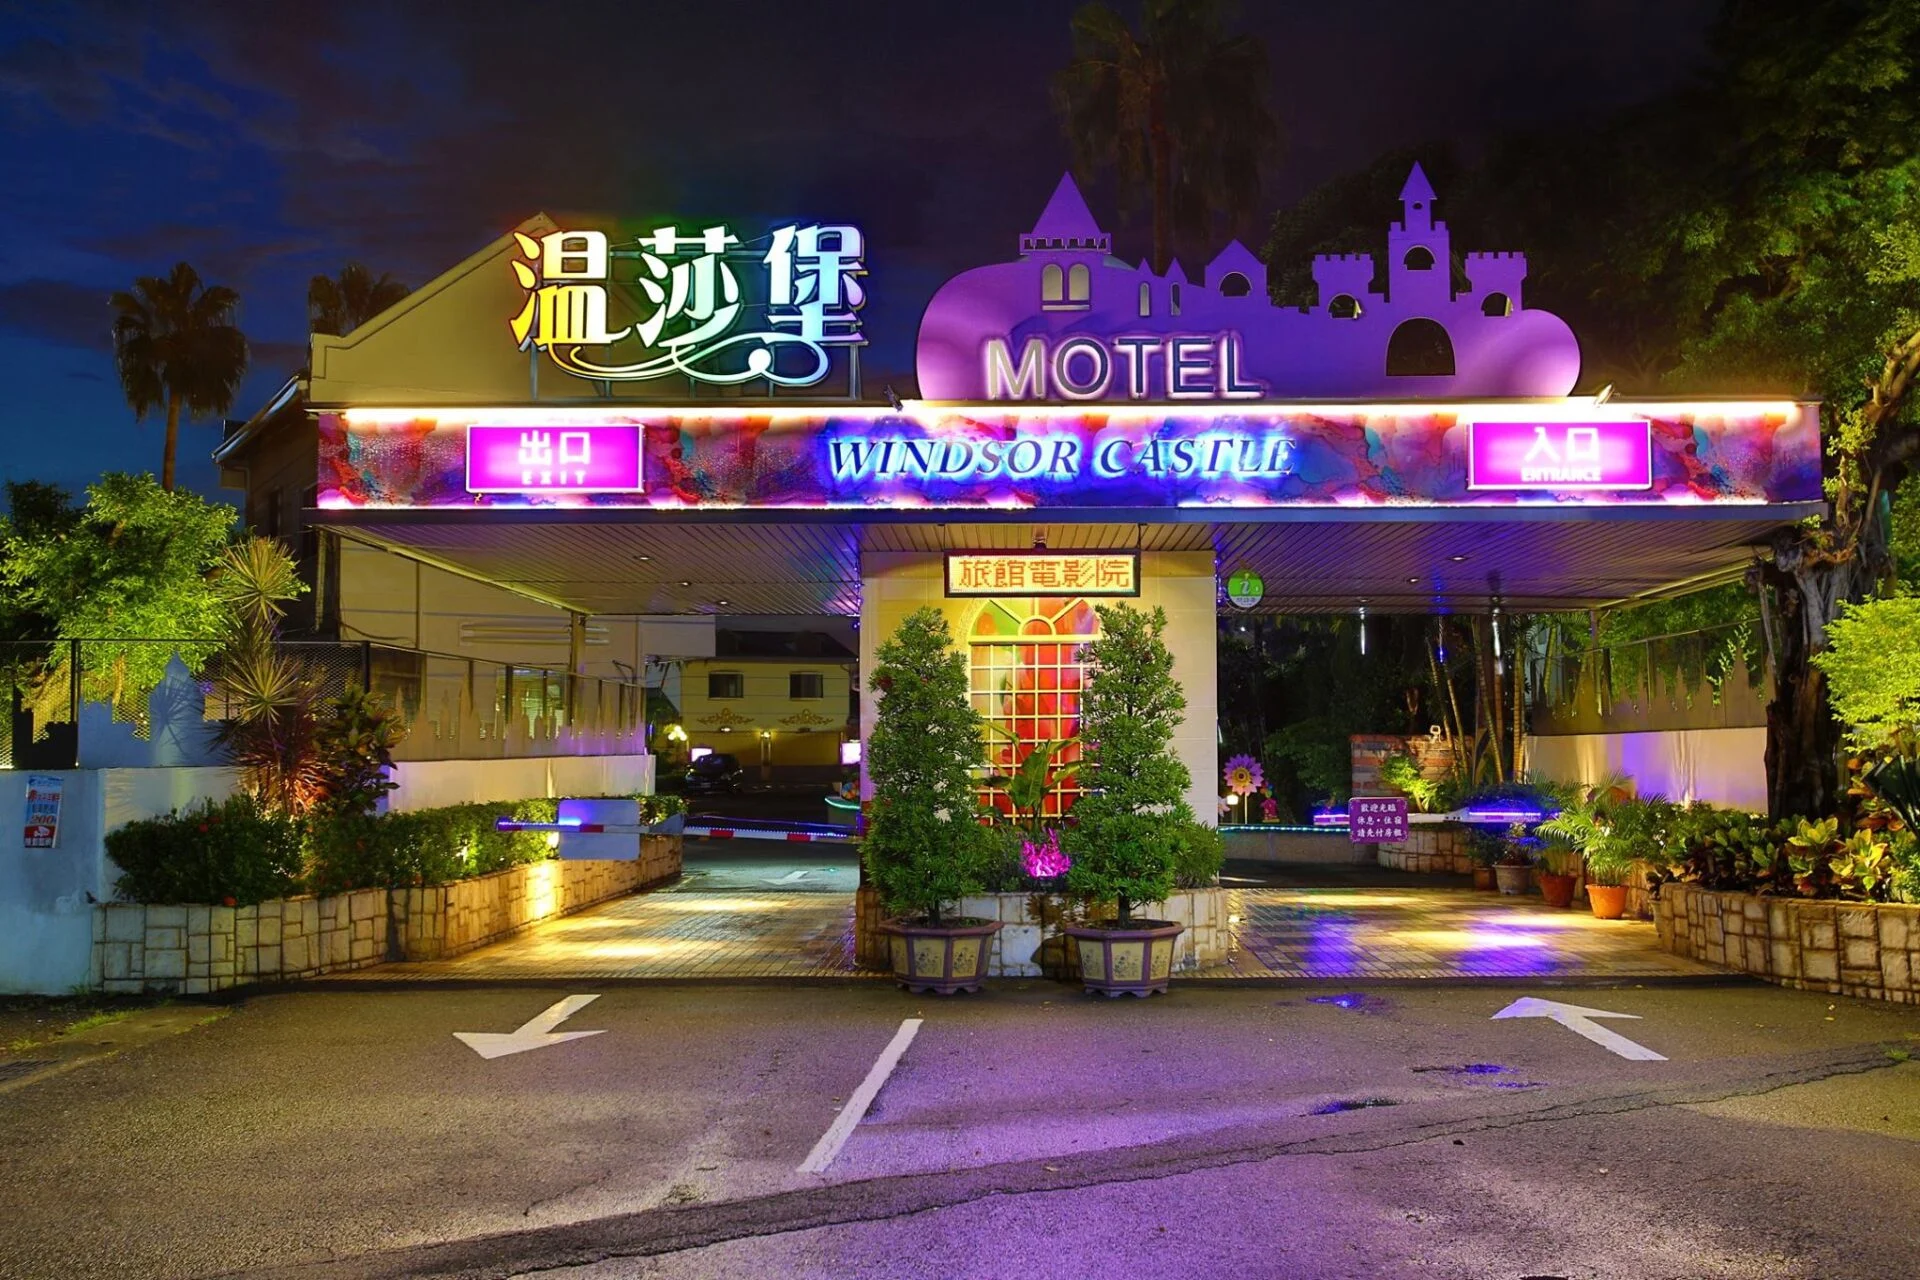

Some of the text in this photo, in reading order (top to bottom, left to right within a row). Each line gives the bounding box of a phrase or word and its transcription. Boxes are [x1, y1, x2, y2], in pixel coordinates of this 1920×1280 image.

[983, 336, 1266, 399] MOTEL
[518, 429, 591, 466] 出口
[830, 437, 1298, 477] WINDSOR CASTLE
[1523, 426, 1601, 462] 入口
[521, 471, 587, 485] EXIT
[1520, 467, 1602, 482] ENTRANCE
[958, 559, 1130, 588] 旅館電影院
